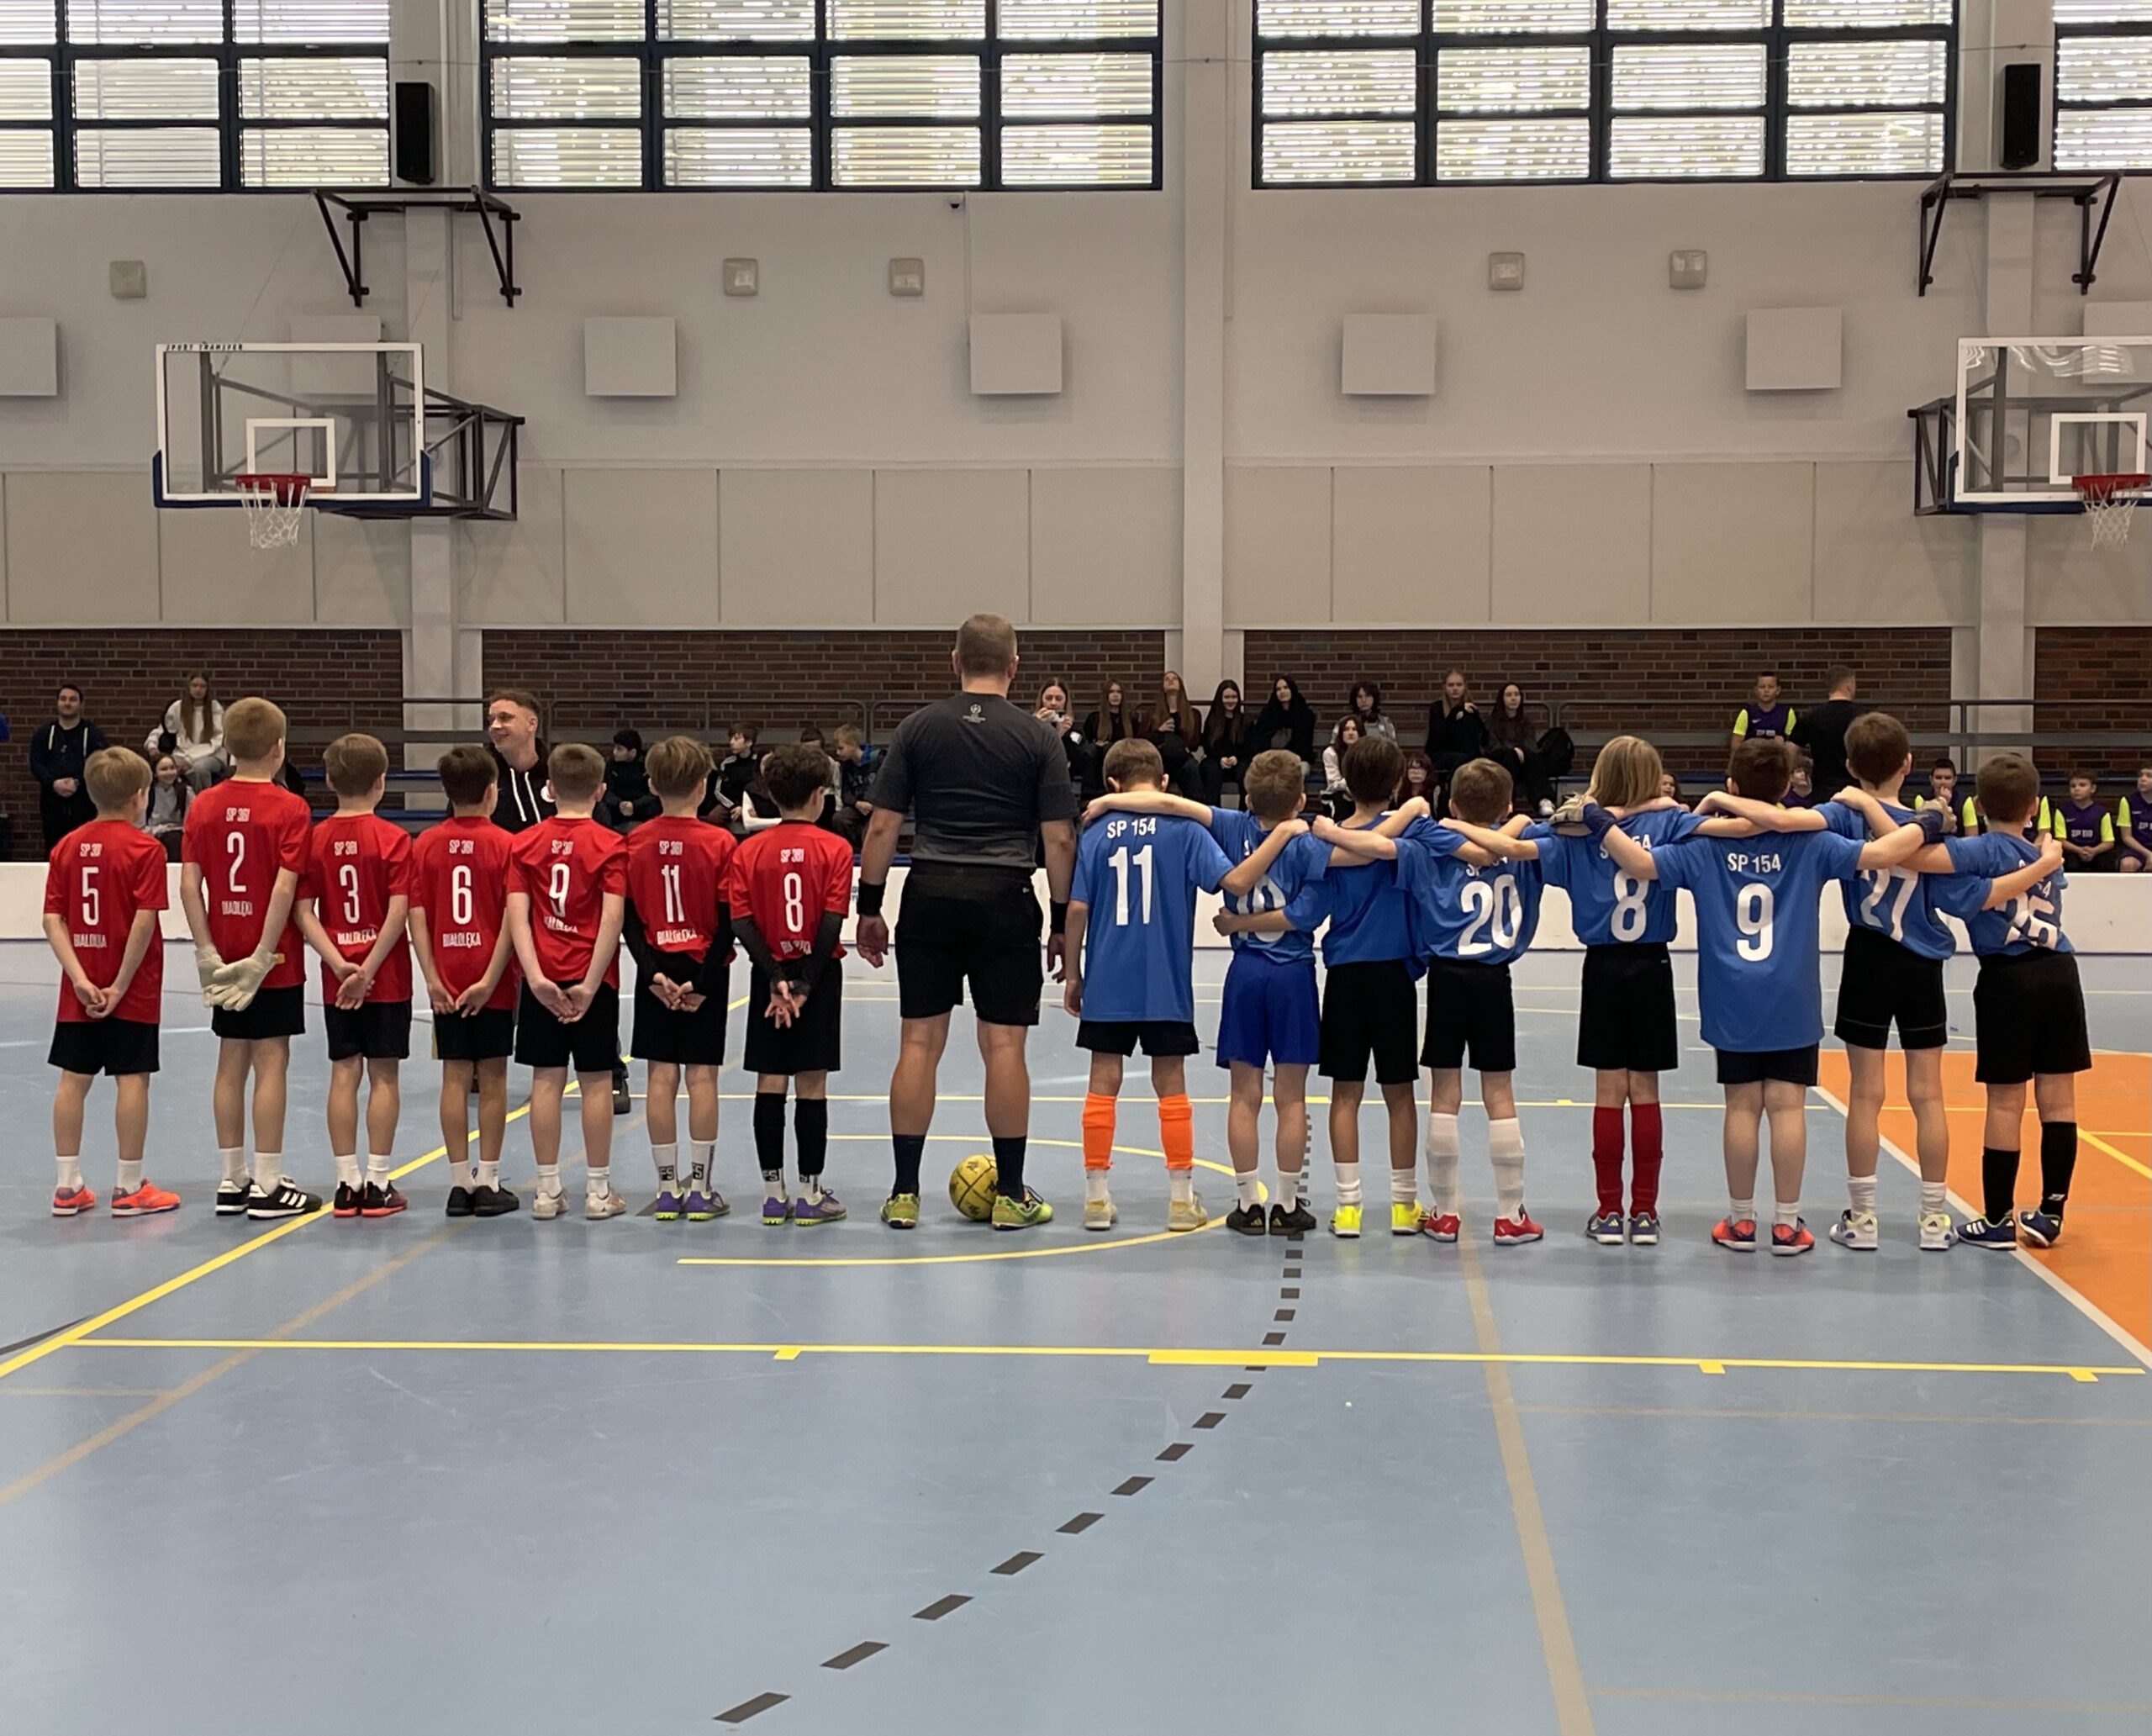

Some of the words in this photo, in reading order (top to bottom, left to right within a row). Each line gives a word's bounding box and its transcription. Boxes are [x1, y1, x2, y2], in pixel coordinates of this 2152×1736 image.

[225, 807, 238, 822] SP
[1107, 820, 1127, 839] SP
[1131, 817, 1156, 836] 154
[80, 842, 91, 857] SP
[226, 831, 246, 893] 2
[334, 841, 345, 857] SP
[449, 839, 461, 854] SP
[659, 840, 670, 855] SP
[780, 848, 791, 863] SP
[1727, 852, 1748, 872] SP
[1752, 853, 1781, 873] 154
[82, 866, 99, 926] 5
[339, 864, 360, 924] 3
[452, 864, 472, 926] 6
[548, 863, 570, 918] 9
[661, 864, 685, 923] 11
[783, 873, 804, 933] 8
[1107, 844, 1152, 926] 11
[1458, 873, 1522, 956] 20
[1611, 869, 1649, 942] 8
[1737, 882, 1774, 962] 9
